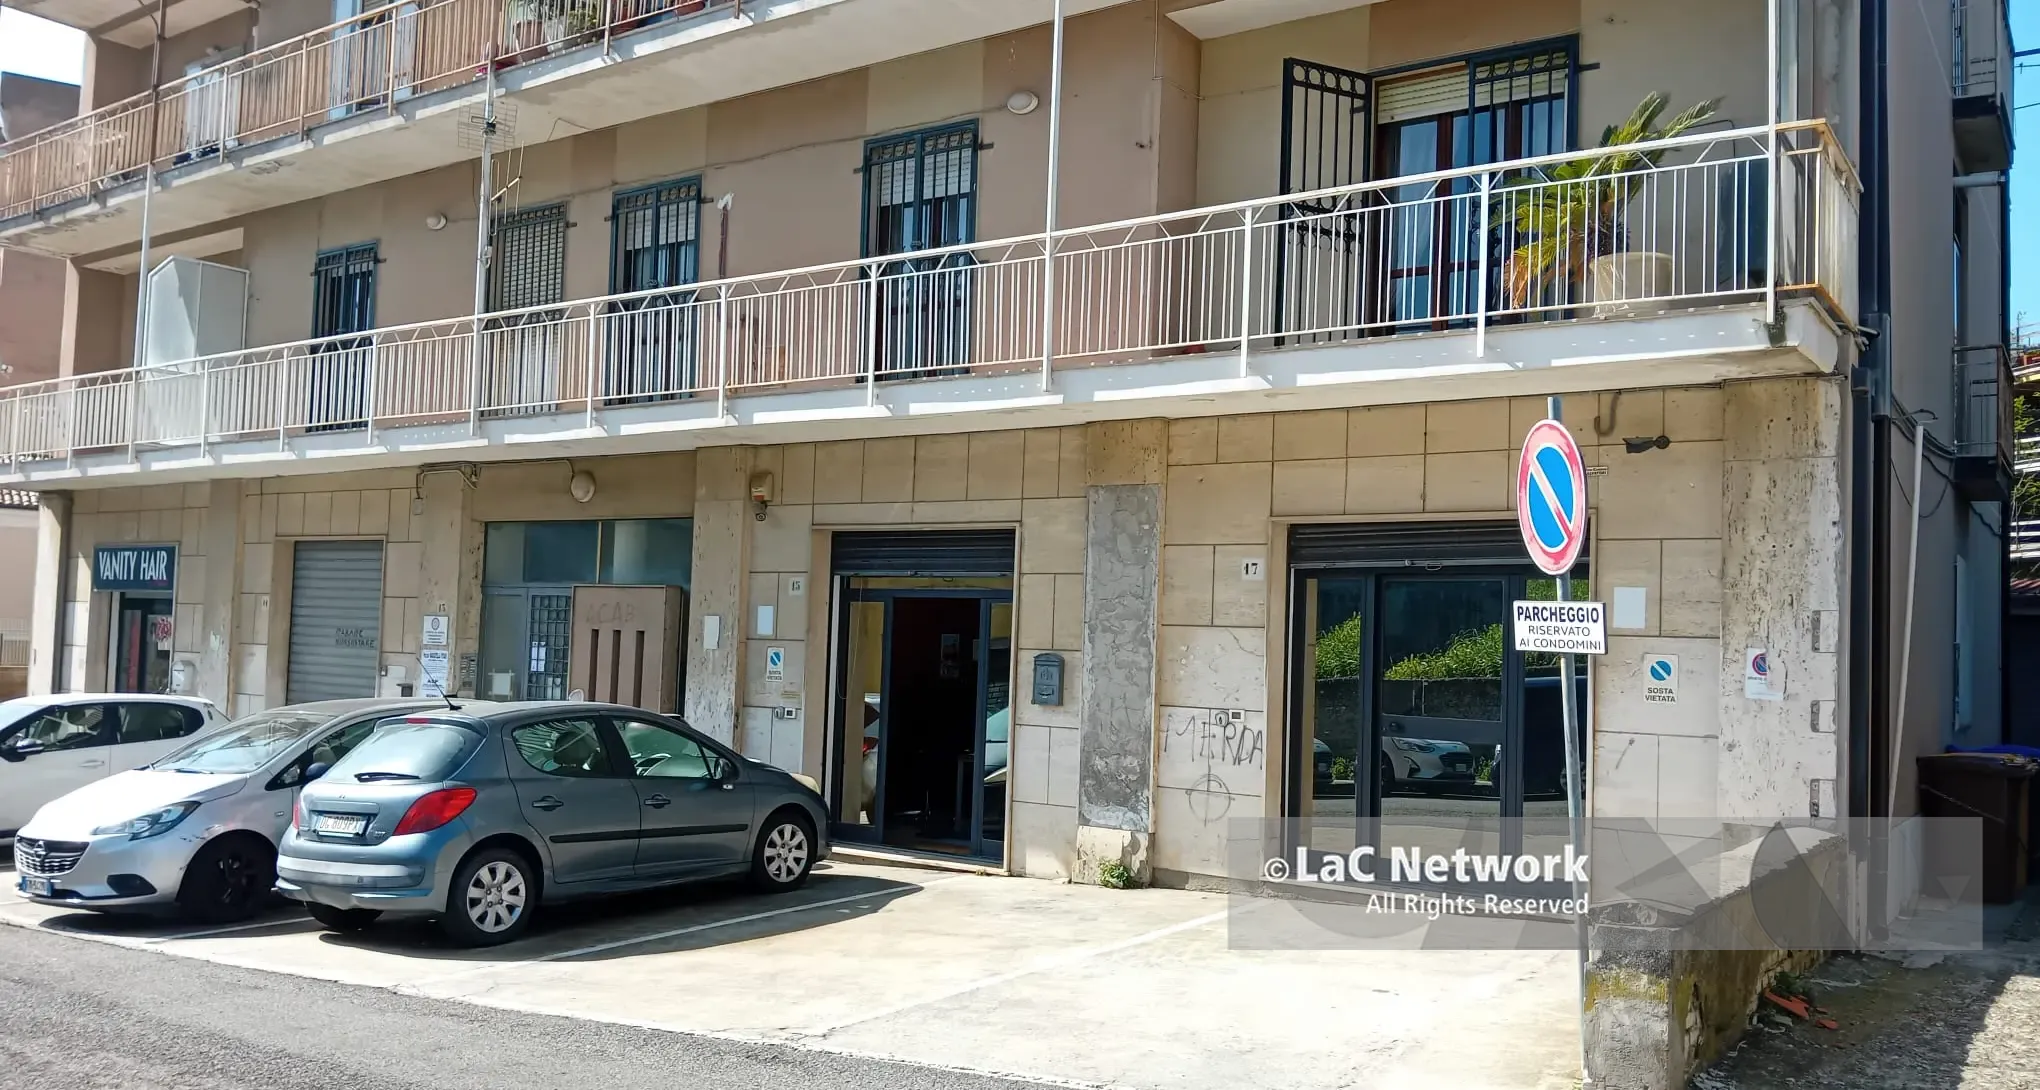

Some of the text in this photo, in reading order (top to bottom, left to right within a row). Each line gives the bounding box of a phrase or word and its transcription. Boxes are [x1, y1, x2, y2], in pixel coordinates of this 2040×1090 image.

[98, 550, 168, 580] VANITY HAIR
[1244, 562, 1259, 575] 17
[1517, 605, 1600, 624] PARCHEGGIO
[1528, 625, 1591, 637] RISERVATO
[1519, 638, 1601, 651] AI CONDOMINI
[1645, 694, 1676, 703] VIETATA
[1164, 713, 1264, 771] MERDA
